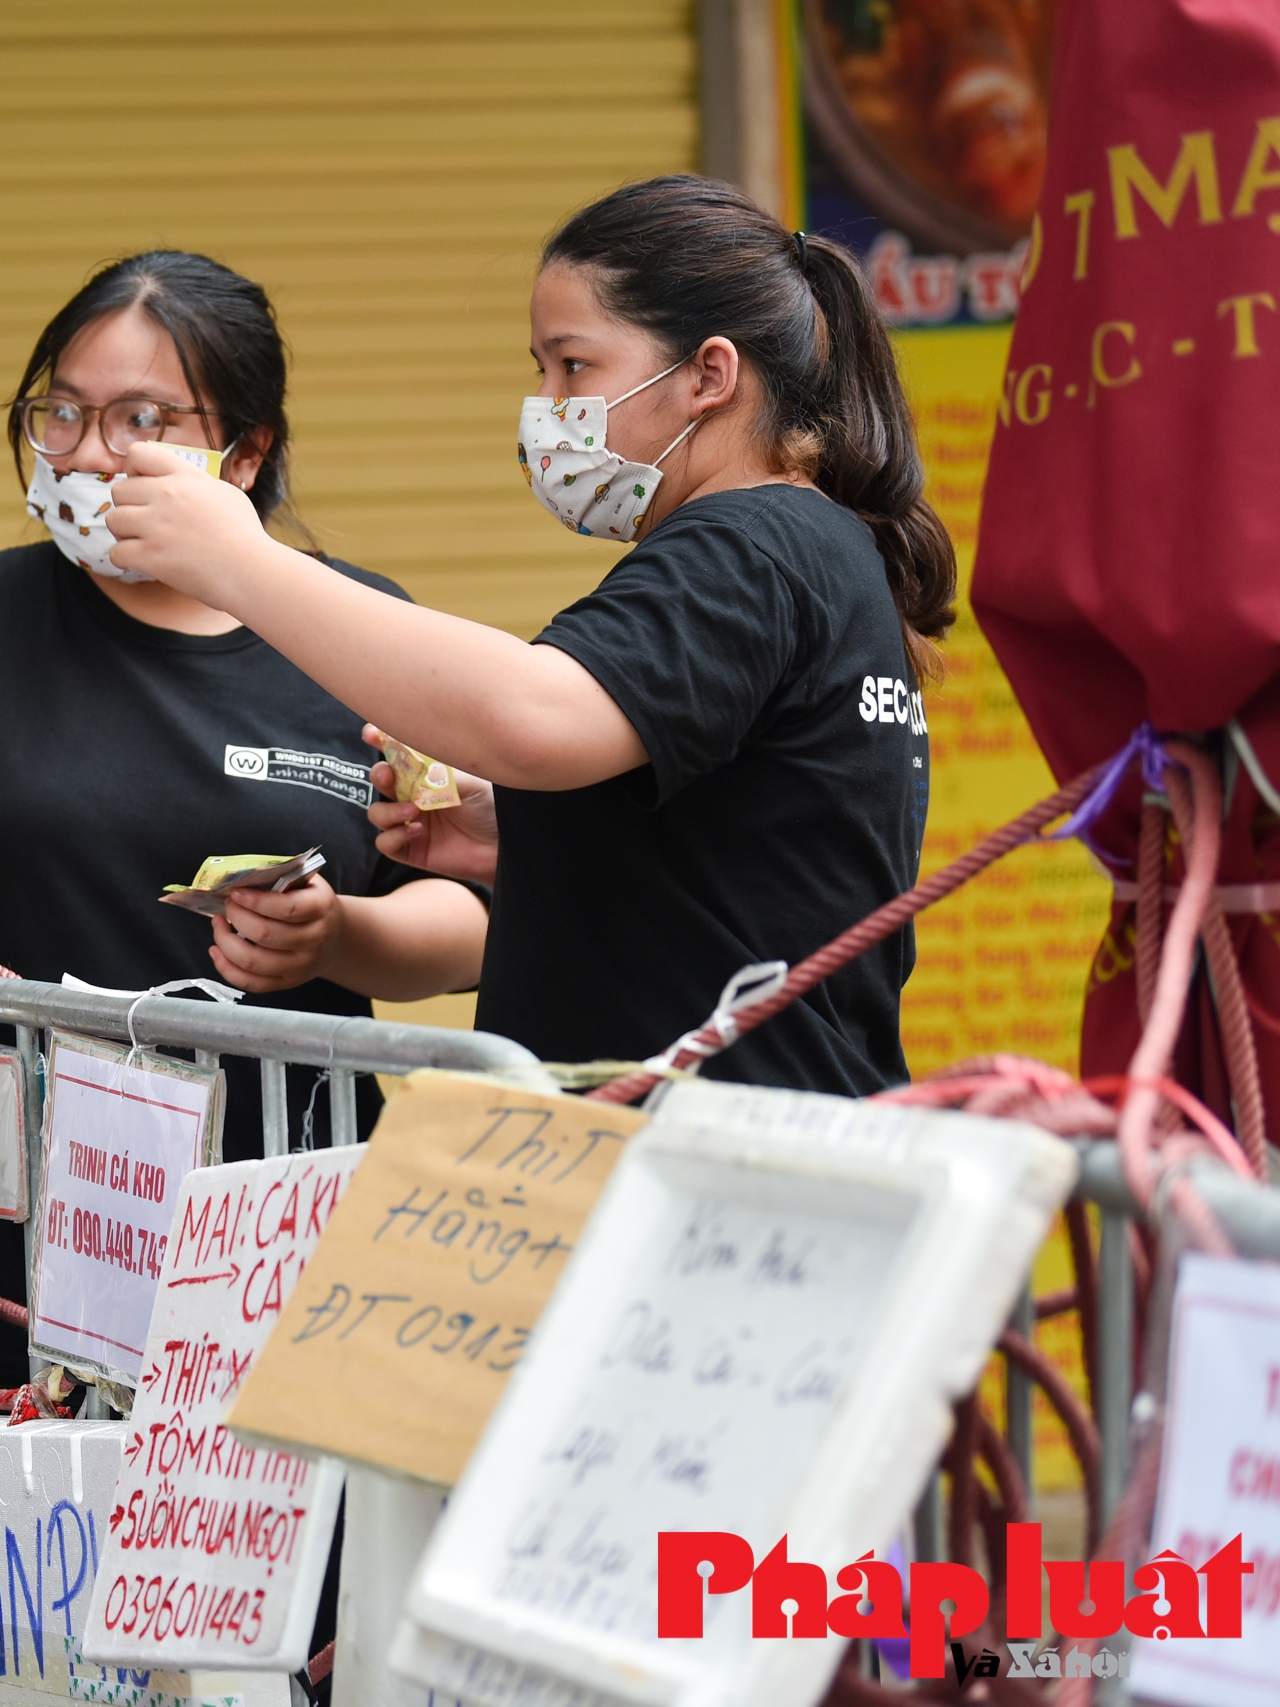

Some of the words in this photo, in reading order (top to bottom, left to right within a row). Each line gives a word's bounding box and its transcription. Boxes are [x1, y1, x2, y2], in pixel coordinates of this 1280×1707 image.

[68, 1141, 106, 1187] TRINH
[110, 1149, 129, 1194] CÁ
[132, 1161, 165, 1204] KHO
[47, 1198, 68, 1249] ĐT:
[256, 1165, 314, 1249] CÁ
[146, 1410, 207, 1476] TÔM
[105, 1575, 265, 1646] 0396011443
